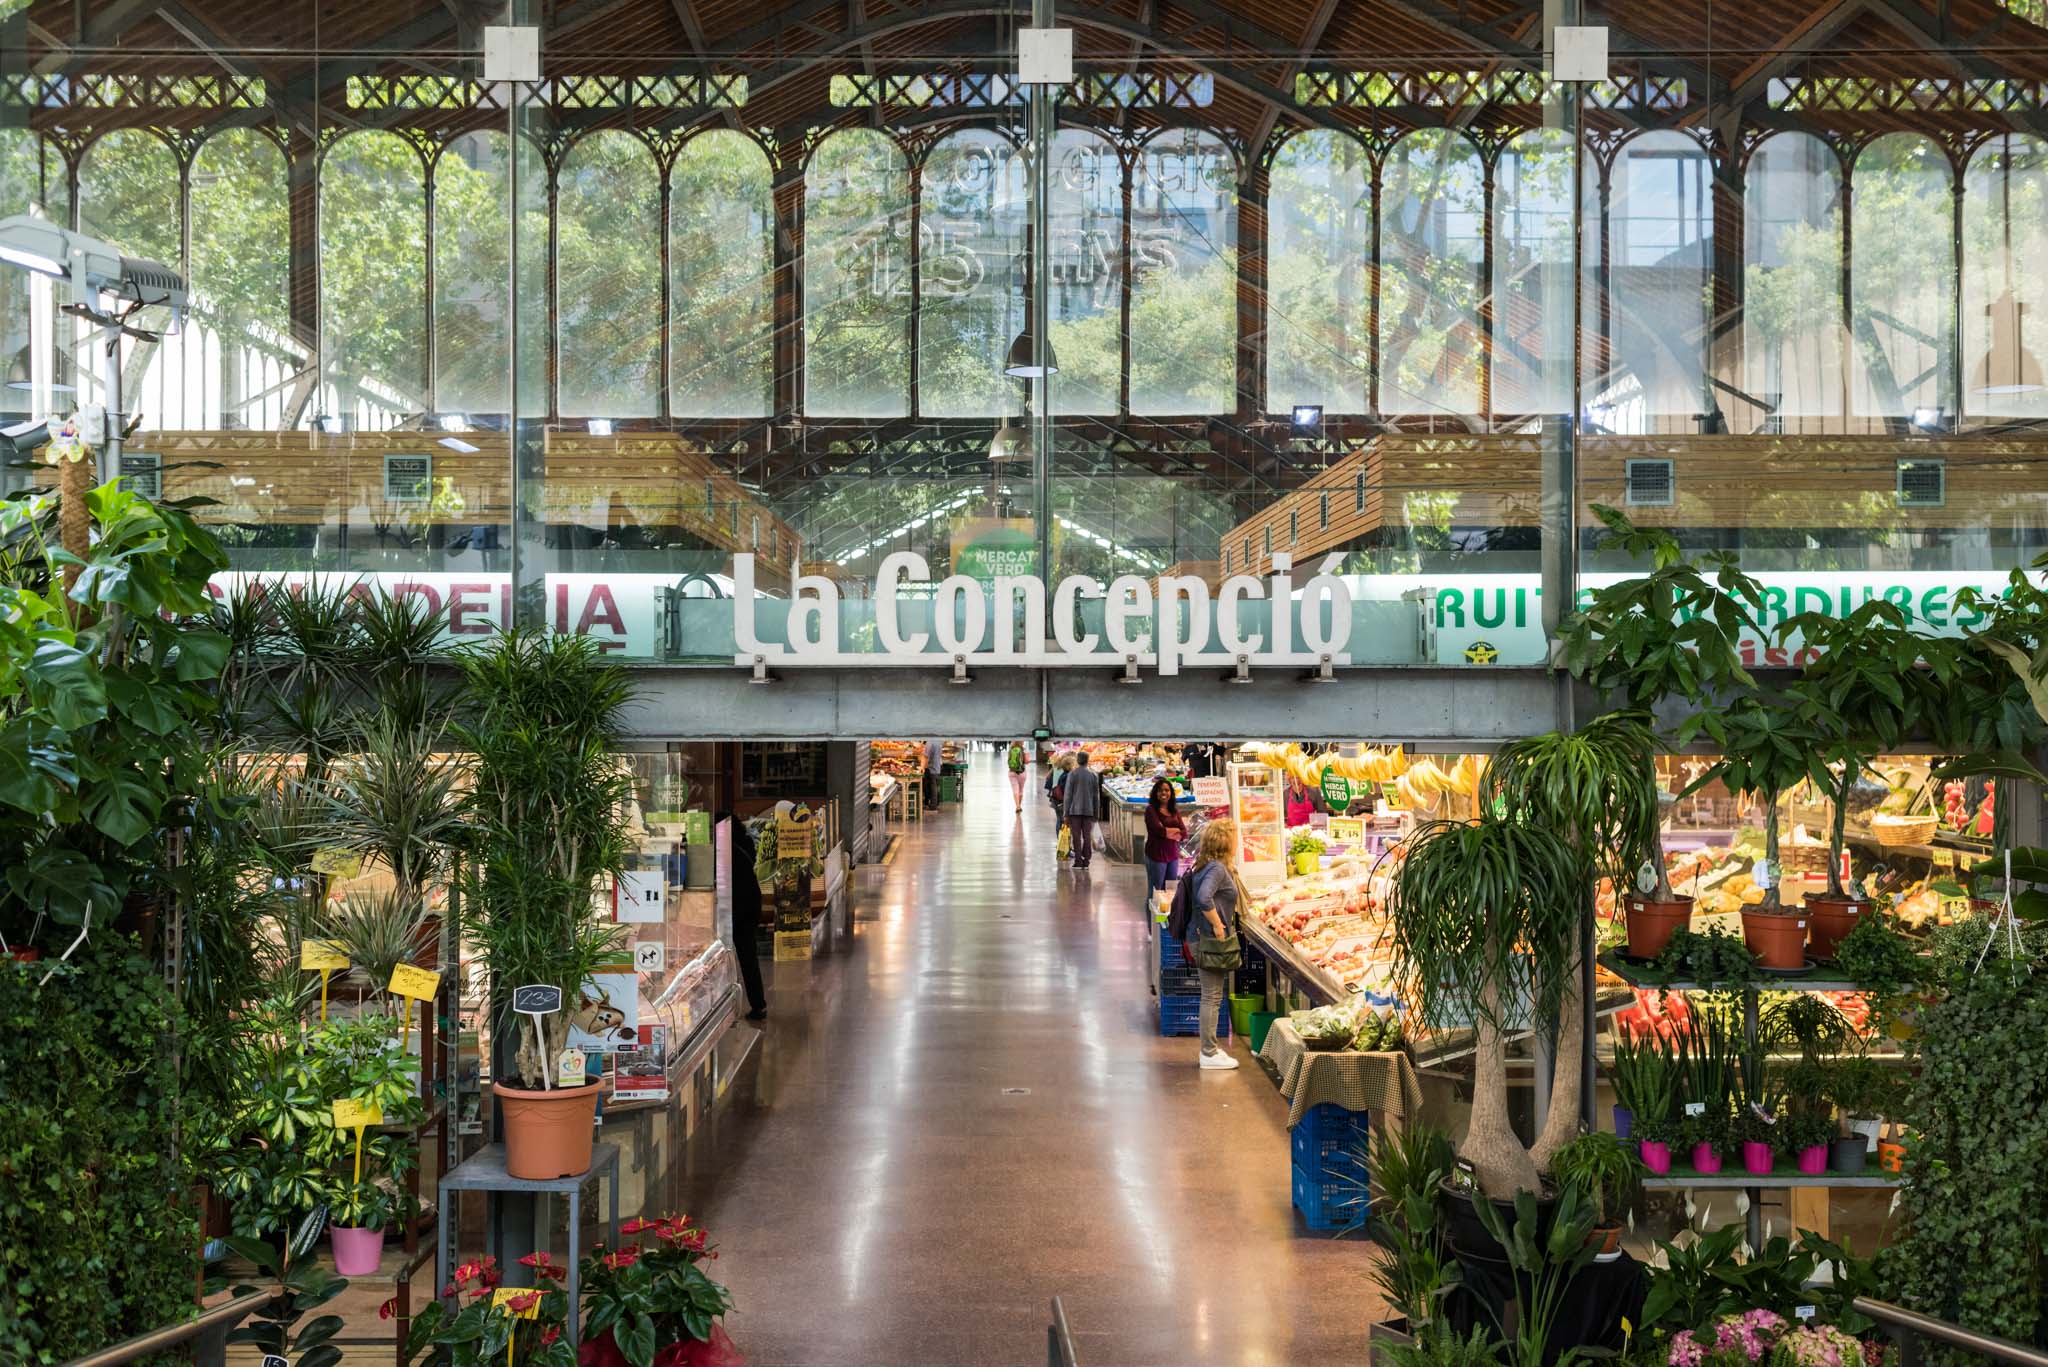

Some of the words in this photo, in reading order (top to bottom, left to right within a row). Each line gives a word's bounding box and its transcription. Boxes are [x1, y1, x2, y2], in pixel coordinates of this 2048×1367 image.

[975, 551, 1034, 562] MERCAT
[986, 563, 1025, 575] VERD
[734, 552, 840, 656] La
[875, 551, 1352, 675] Concepció
[1325, 782, 1346, 791] MERCAT
[1326, 791, 1348, 801] VERD
